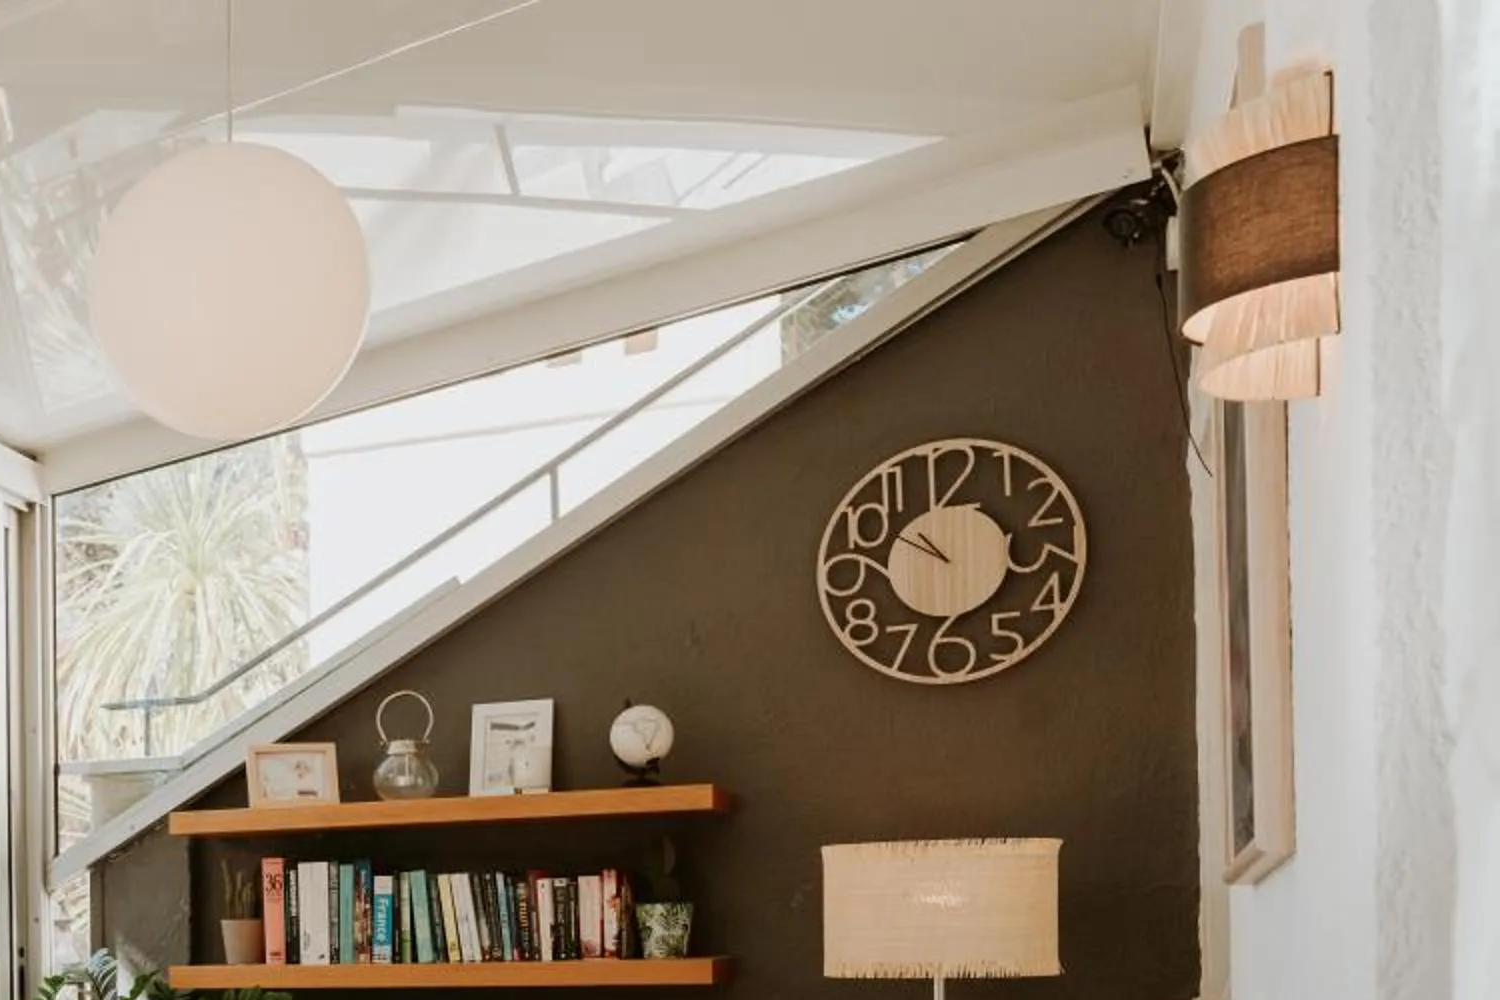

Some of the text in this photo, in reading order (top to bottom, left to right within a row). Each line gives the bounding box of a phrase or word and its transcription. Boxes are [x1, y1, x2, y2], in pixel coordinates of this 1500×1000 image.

[880, 466, 904, 515] 11
[927, 445, 981, 511] 12
[994, 450, 1012, 497] 1
[841, 503, 888, 549] 10
[1027, 478, 1064, 527] 2
[822, 554, 890, 597] 9
[1030, 572, 1068, 625] 4
[844, 599, 879, 647] 8
[928, 614, 977, 677] 6
[989, 612, 1025, 662] 5
[886, 624, 919, 672] 7
[375, 897, 389, 943] France
